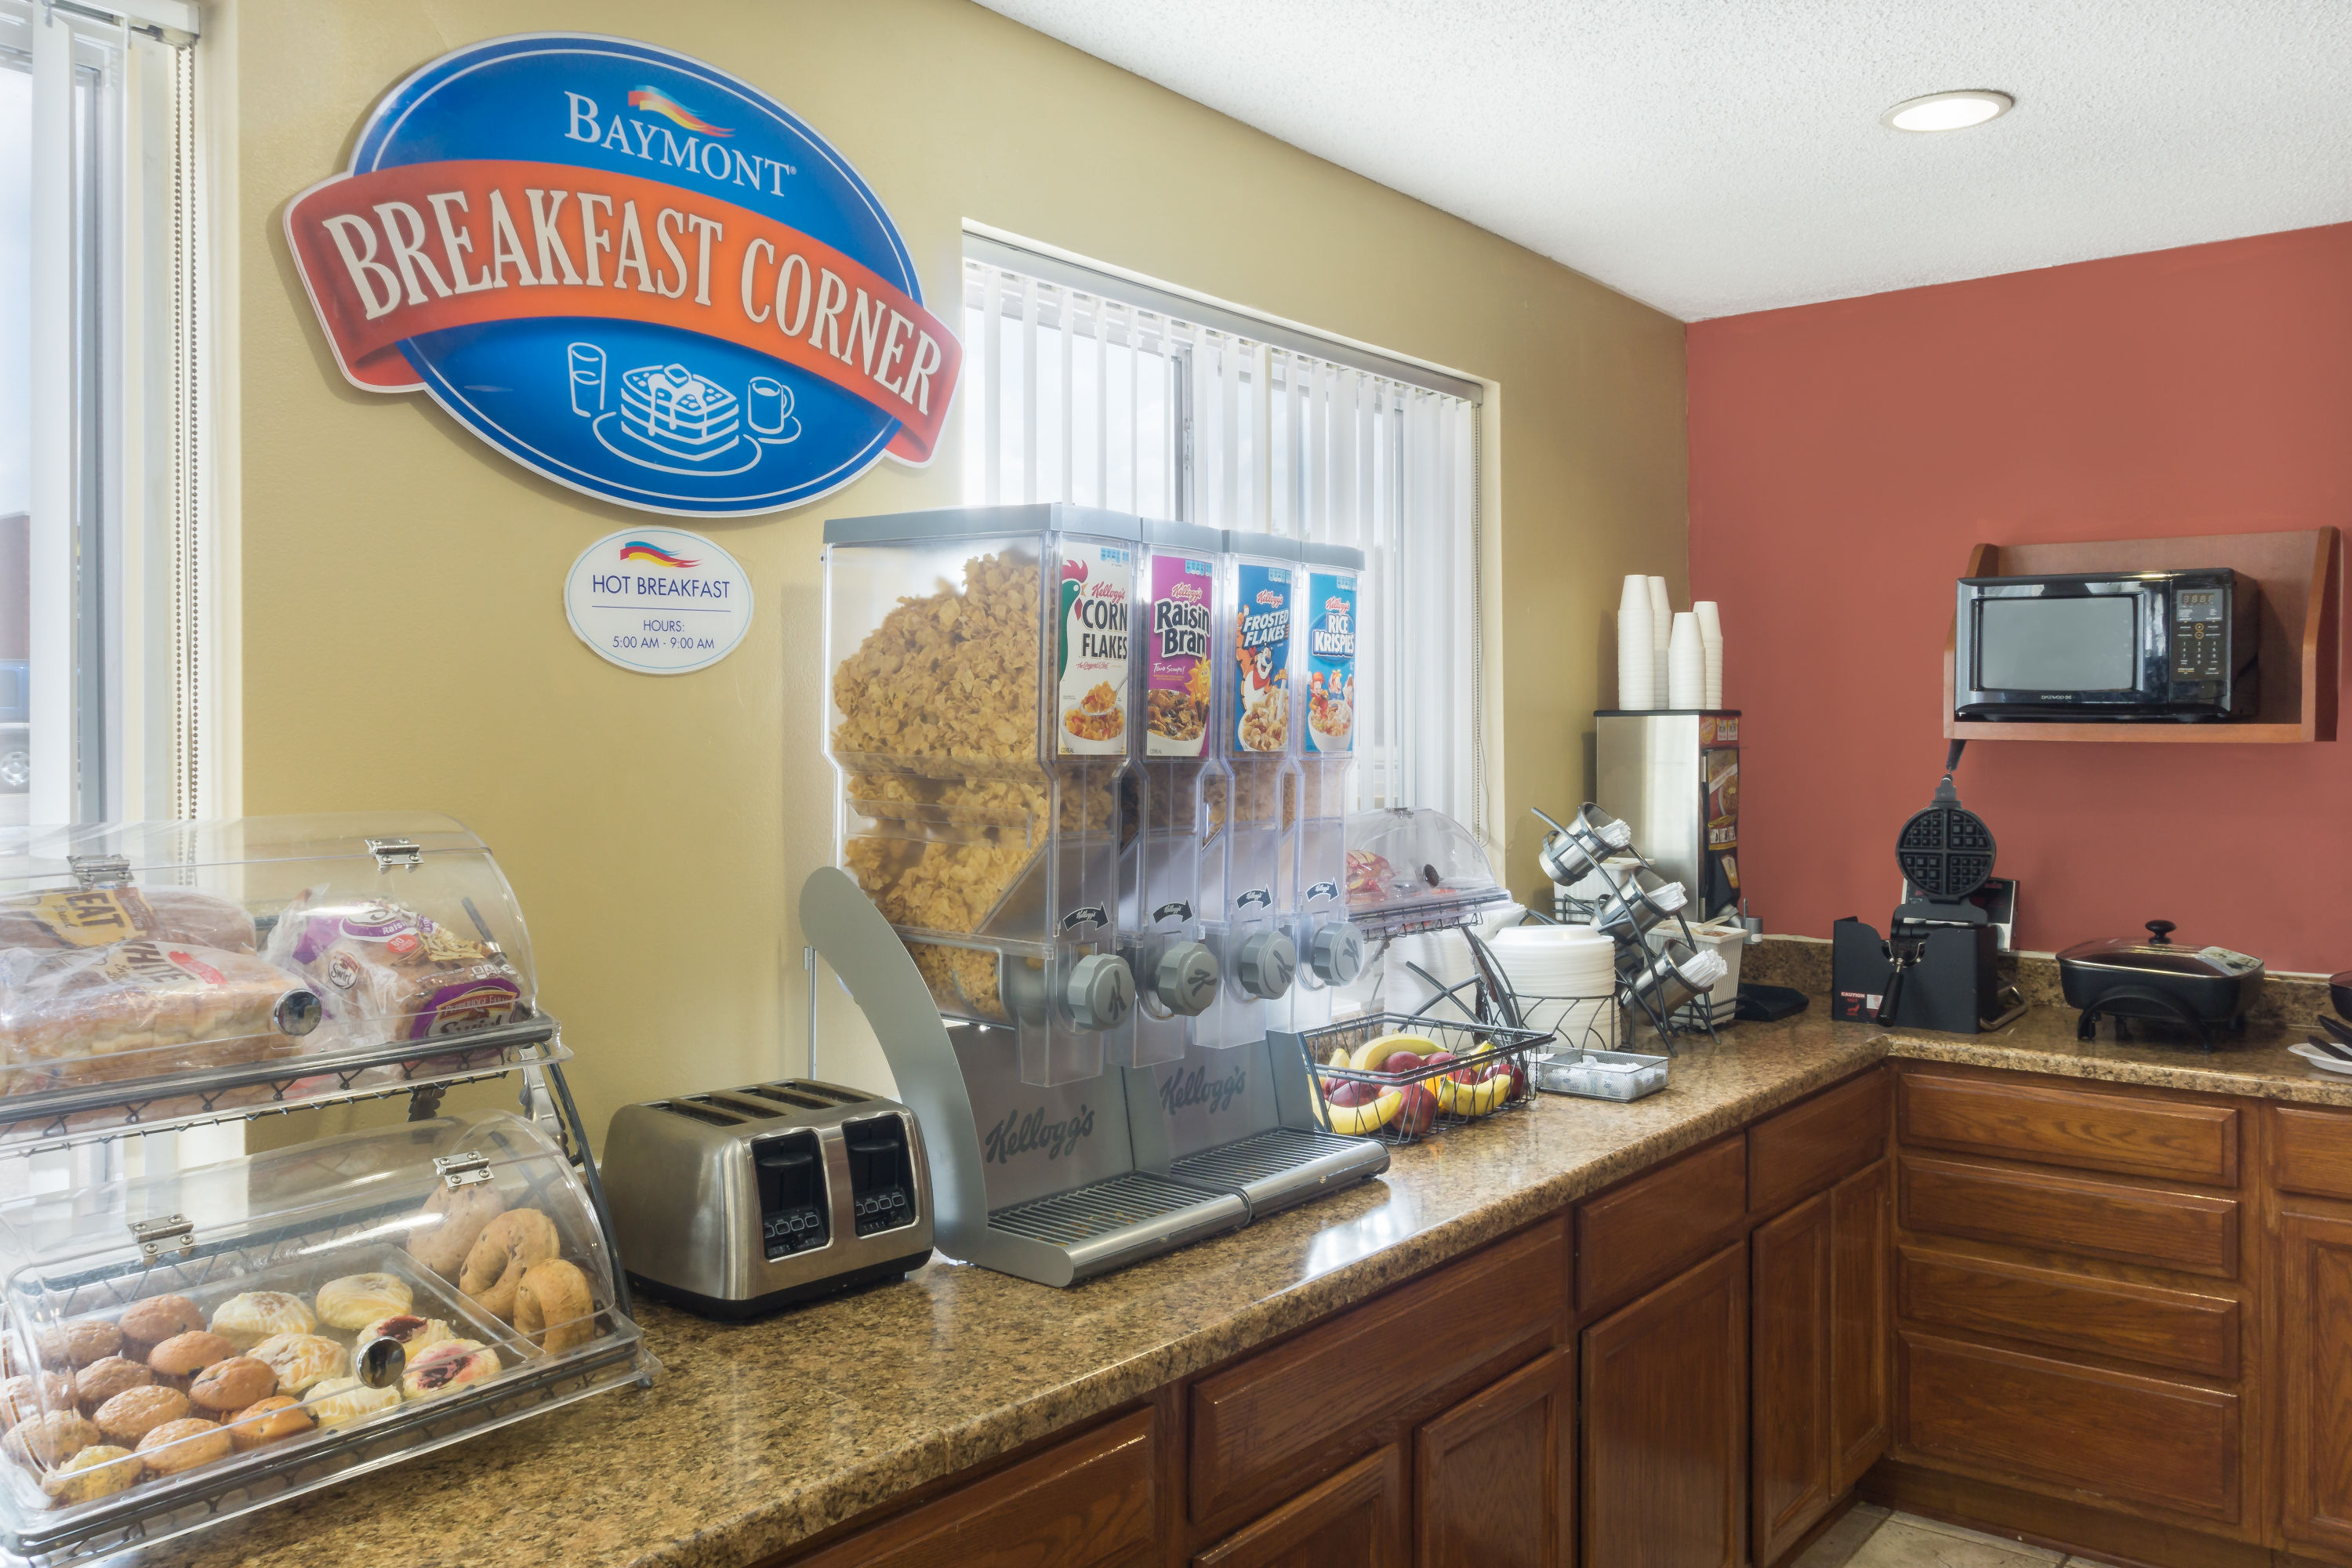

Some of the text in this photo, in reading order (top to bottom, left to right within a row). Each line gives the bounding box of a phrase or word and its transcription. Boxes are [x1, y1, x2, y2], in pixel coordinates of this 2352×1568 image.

[564, 90, 789, 197] BAYMONT
[321, 187, 942, 416] BREAKFAST CORNER
[592, 575, 730, 598] HOT BREAKFAST
[1092, 580, 1126, 604] Kellogg's
[1172, 583, 1202, 602] Kellogg's
[1256, 590, 1283, 608] Kellogg's
[1326, 596, 1349, 614] Kellogg's
[643, 619, 684, 632] HOURS:
[1082, 599, 1127, 632] CORN
[1156, 601, 1210, 635] Raisin
[1243, 610, 1289, 633] FROSTED
[1328, 614, 1348, 634] RICE
[612, 636, 637, 648] 5:00
[641, 637, 659, 648] AM
[670, 637, 694, 649] 9:00
[697, 638, 714, 649] AM
[1082, 633, 1127, 660] FLAKES
[1163, 628, 1206, 655] Bran
[1243, 624, 1286, 647] FLAKES
[1315, 630, 1354, 653] KRISPIES
[1153, 663, 1166, 674] Two
[1076, 910, 1096, 920] Kellogg's
[331, 964, 352, 985] Swirl
[1160, 1065, 1247, 1116] Kellogg's
[985, 1104, 1095, 1165] Kellogg's
